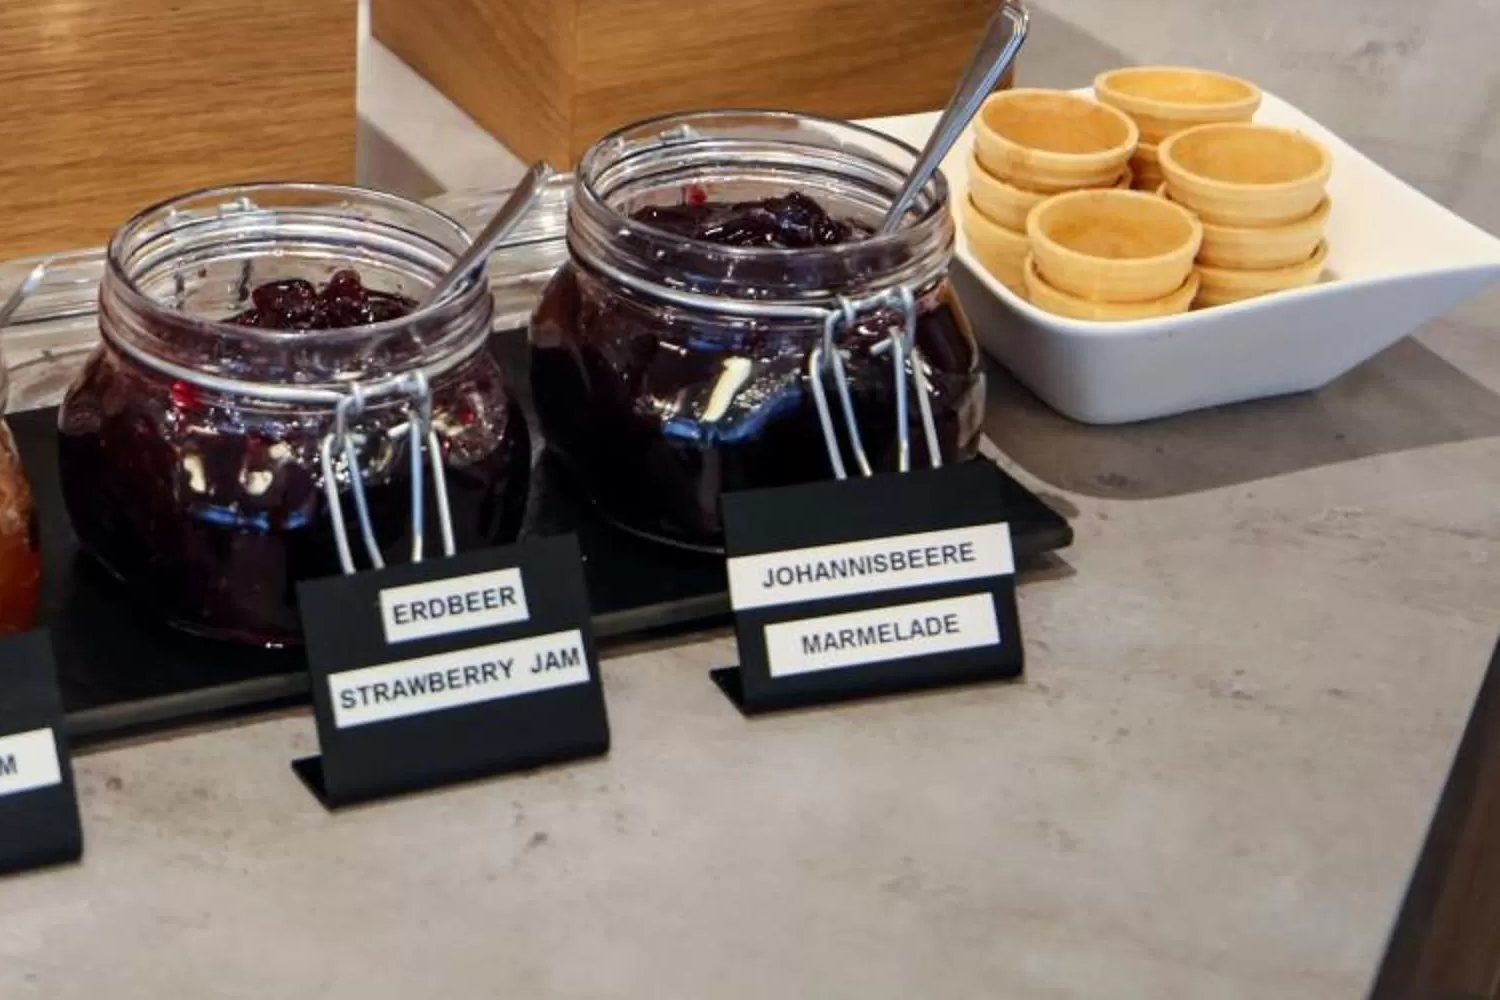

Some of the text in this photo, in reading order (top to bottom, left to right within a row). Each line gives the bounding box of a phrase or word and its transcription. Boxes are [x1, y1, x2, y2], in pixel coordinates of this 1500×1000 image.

[762, 542, 976, 589] JOHANNISBEERE
[392, 586, 518, 626] ERDBEER
[801, 613, 960, 655] MARMELADE
[340, 647, 581, 710] STRAWBERRY JAM
